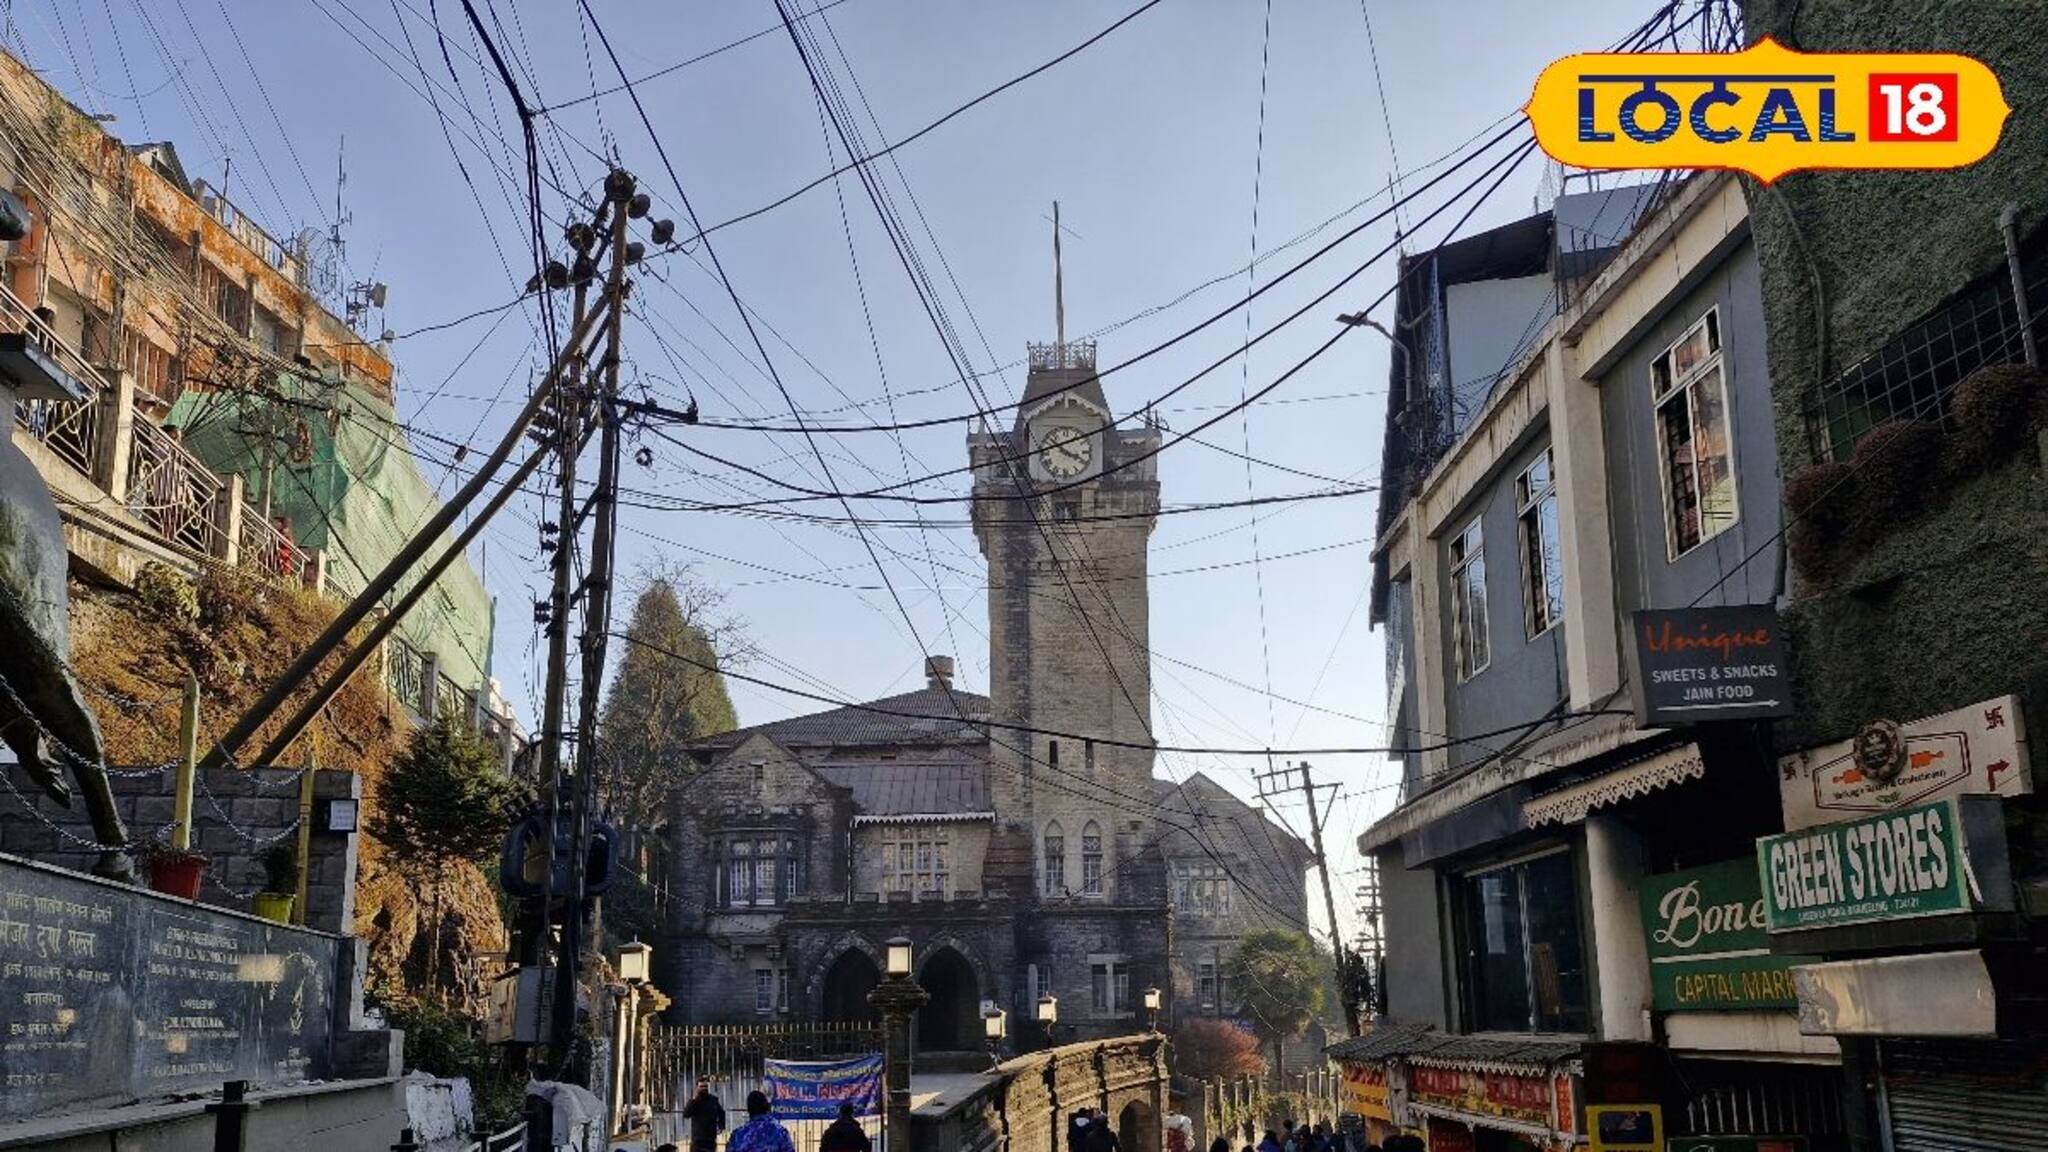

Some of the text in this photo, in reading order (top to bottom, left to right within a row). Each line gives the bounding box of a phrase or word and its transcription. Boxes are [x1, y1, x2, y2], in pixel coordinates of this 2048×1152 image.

[1645, 620, 1771, 661] Unique
[1652, 664, 1777, 683] SWEETS & SNACKS
[1683, 685, 1754, 701] JAIN FOOD
[1770, 808, 1949, 911] GREEN STORES
[1675, 972, 1740, 1003] CAPITAL
